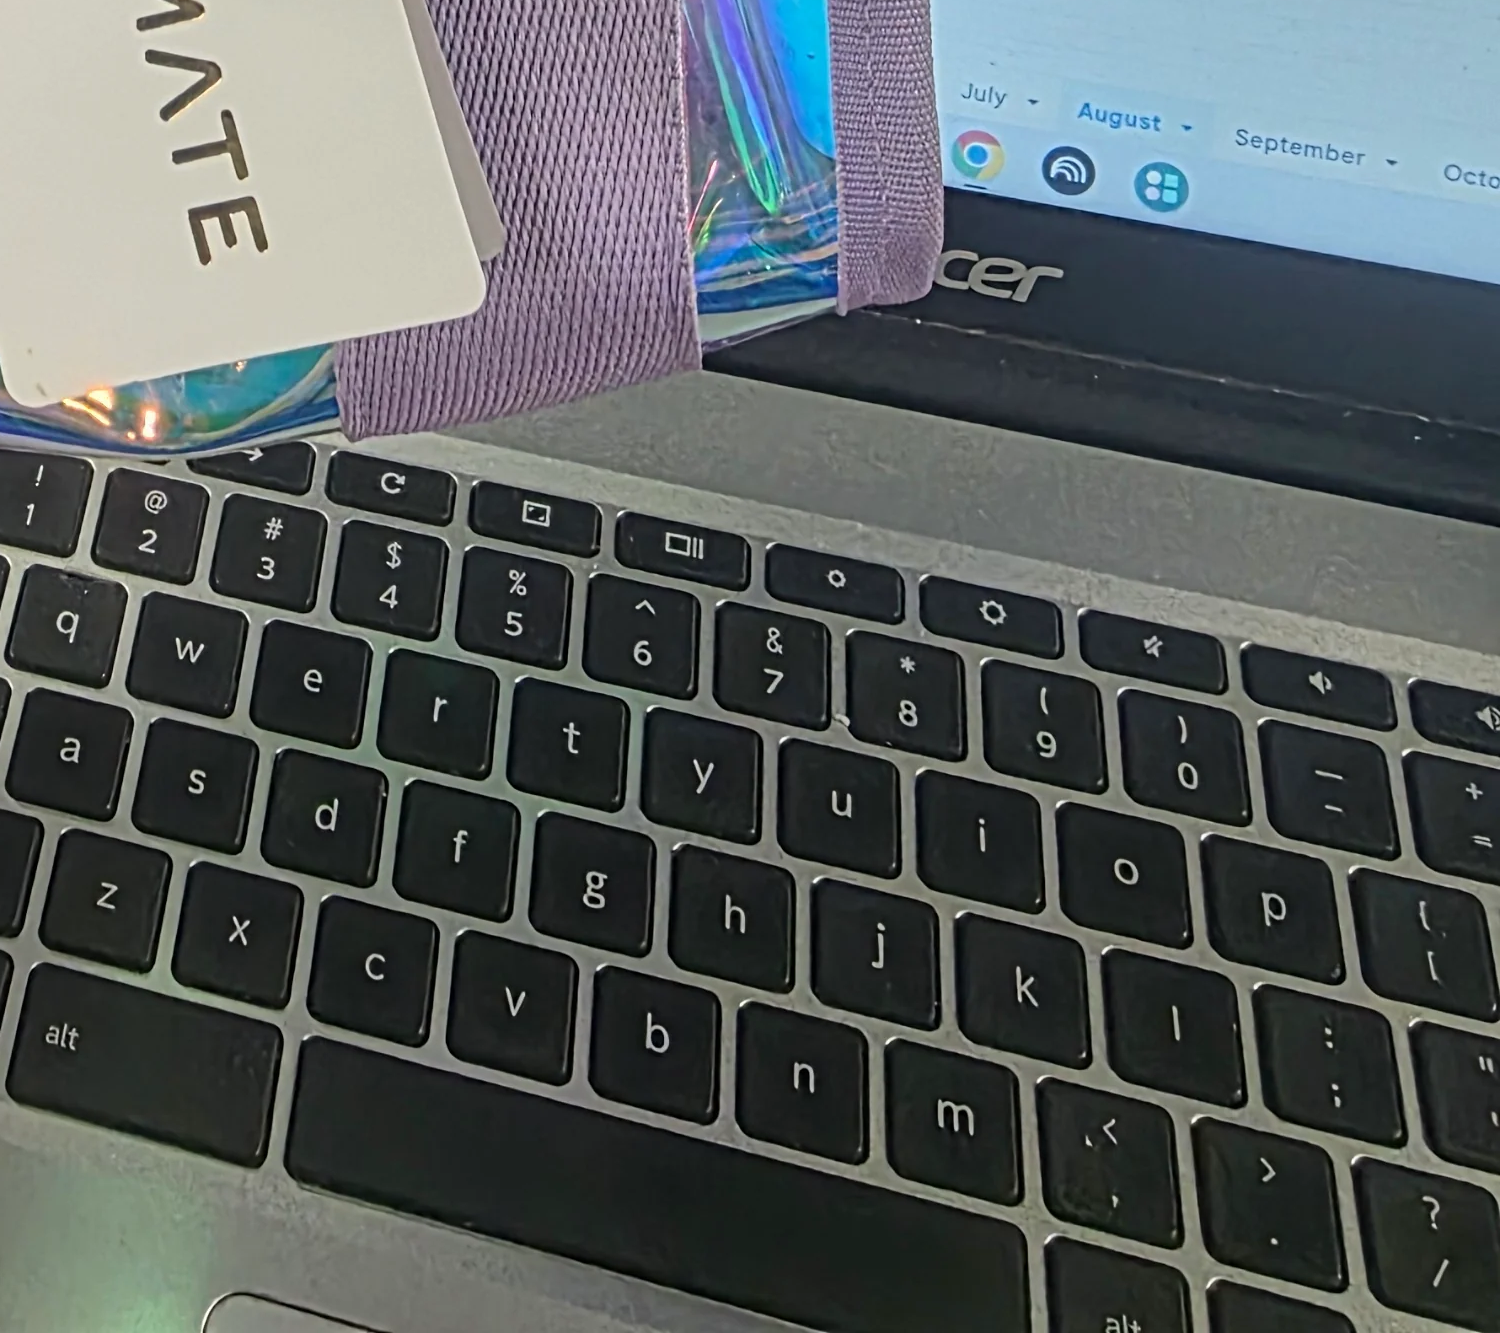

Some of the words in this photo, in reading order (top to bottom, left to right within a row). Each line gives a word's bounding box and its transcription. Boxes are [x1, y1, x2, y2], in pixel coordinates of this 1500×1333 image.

[960, 81, 1009, 110] July
[1077, 101, 1162, 132] August
[1234, 128, 1367, 169] September
[26, 503, 35, 526] 1
[144, 489, 168, 515] @
[138, 529, 158, 554] 2
[264, 517, 284, 541] #
[256, 556, 275, 580] 3
[385, 541, 402, 570] $
[379, 584, 398, 609] 4
[508, 569, 527, 596] %
[56, 610, 80, 644] q
[504, 611, 523, 637] 5
[175, 637, 205, 663] w
[633, 640, 653, 666] 6
[303, 669, 323, 693] e
[763, 668, 784, 694] 7
[433, 696, 448, 723] r
[898, 699, 918, 727] 8
[60, 737, 81, 764] a
[562, 722, 581, 754] t
[1036, 731, 1057, 758] 9
[188, 769, 206, 795] s
[692, 758, 715, 794] y
[314, 798, 339, 832] d
[831, 790, 852, 818] u
[453, 829, 468, 863] f
[978, 818, 986, 852] i
[1114, 858, 1139, 885] o
[96, 882, 119, 910] z
[582, 871, 608, 909] g
[725, 894, 746, 934] h
[1261, 892, 1287, 927] p
[228, 915, 251, 946] x
[871, 922, 886, 969] j
[365, 953, 386, 981] c
[1015, 966, 1039, 1007] k
[505, 986, 526, 1017] v
[45, 1023, 79, 1051] alt
[645, 1012, 670, 1054] b
[793, 1062, 815, 1094] n
[937, 1099, 975, 1136] m
[1422, 1195, 1440, 1230] ?
